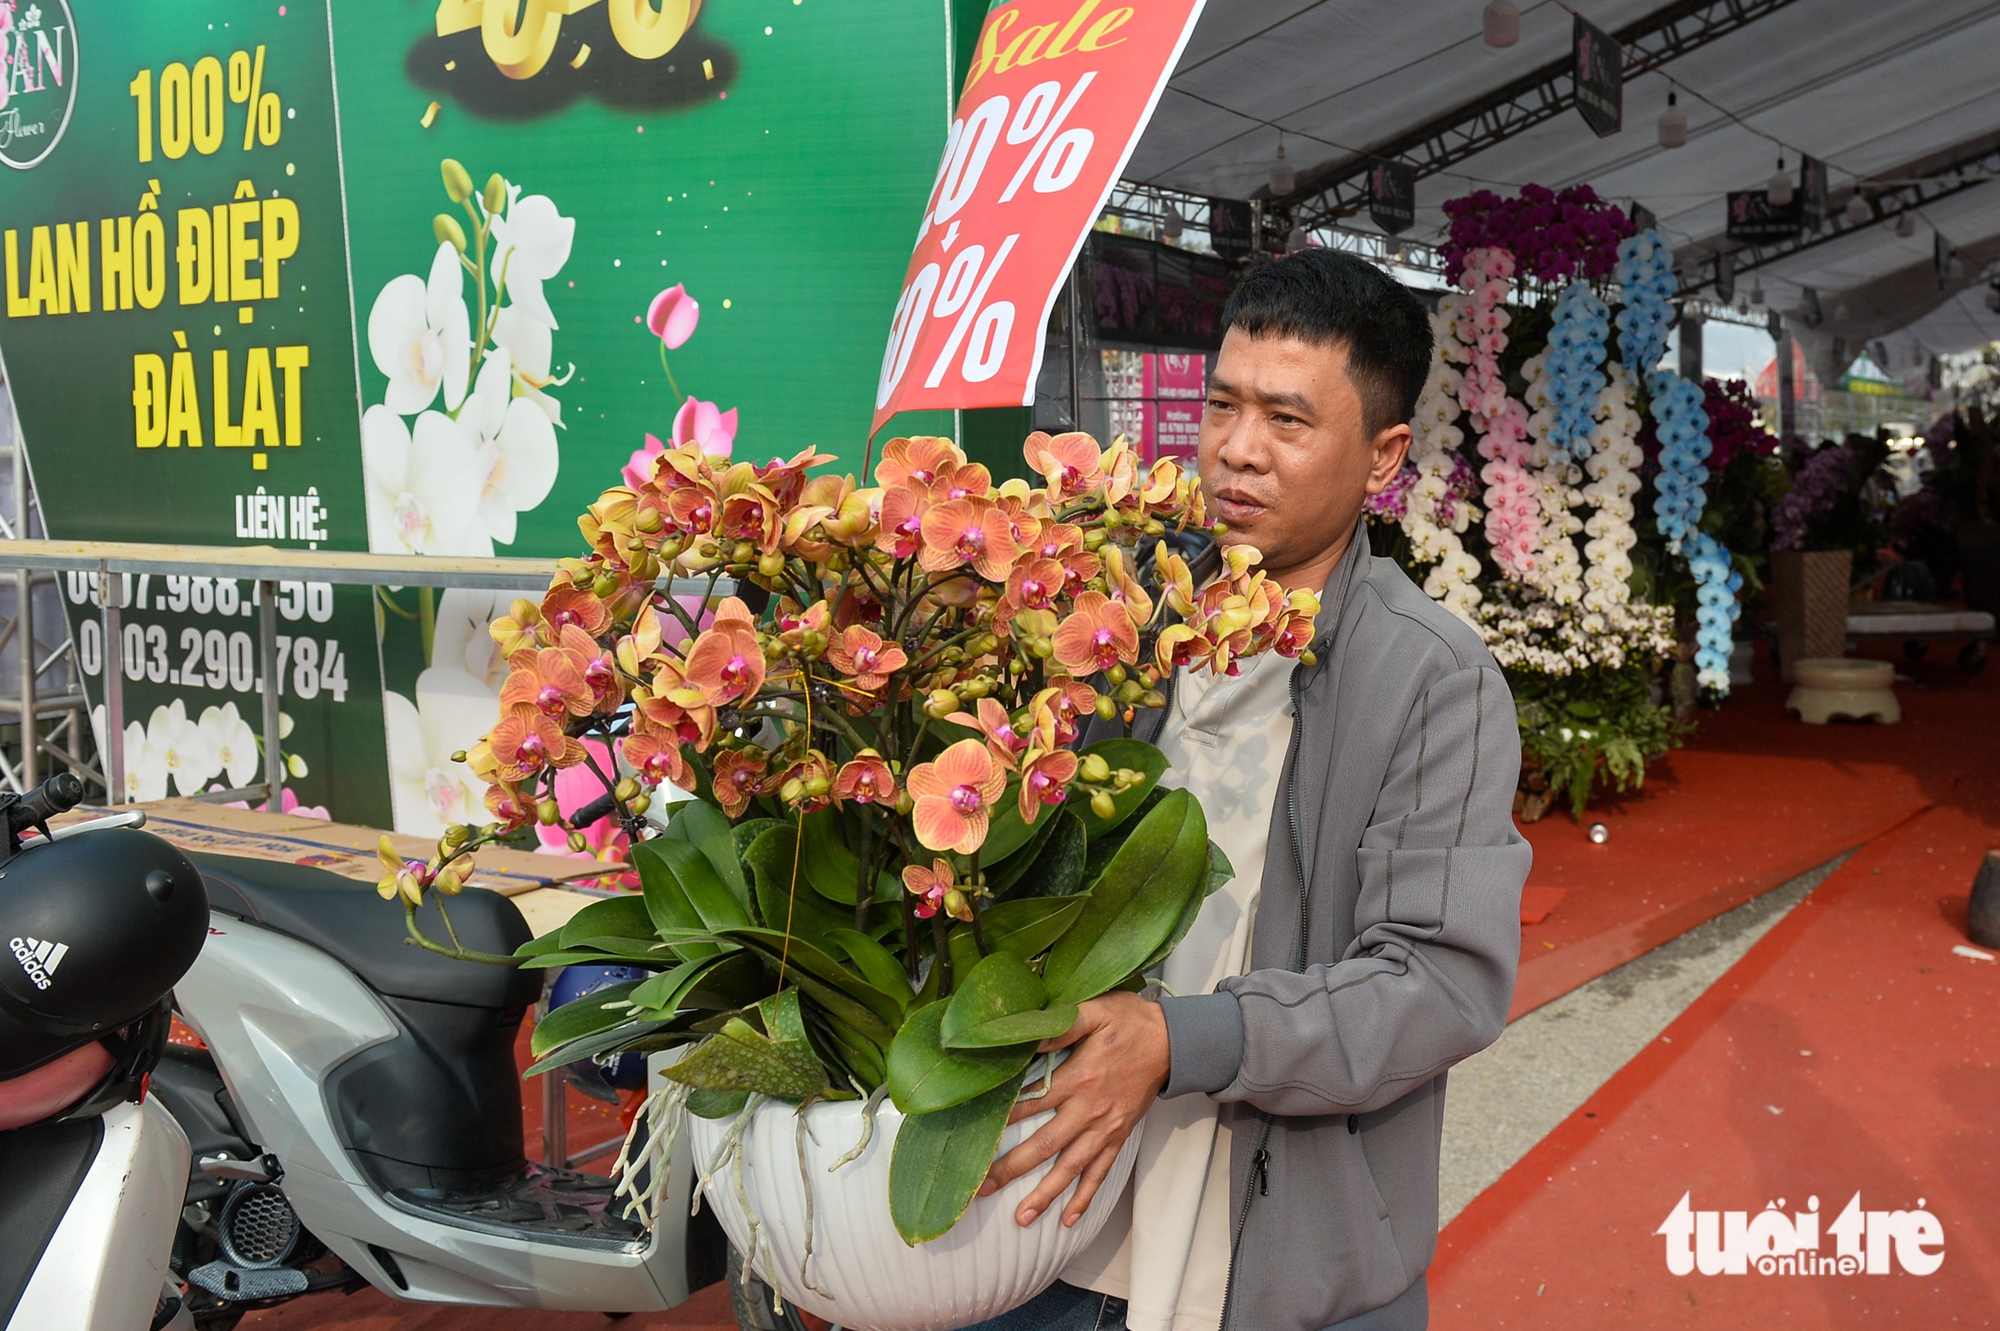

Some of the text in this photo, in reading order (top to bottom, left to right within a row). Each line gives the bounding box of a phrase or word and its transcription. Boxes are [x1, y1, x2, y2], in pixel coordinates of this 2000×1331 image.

[960, 0, 1134, 100] Sale
[130, 45, 282, 163] 100%
[4, 178, 300, 324] LAN HỒ ĐIỆP
[132, 330, 309, 471] ĐÀ LẠT
[235, 485, 328, 550] LIÊN HỆ:
[80, 619, 348, 702] 003.290.784
[9, 937, 52, 990] adidas
